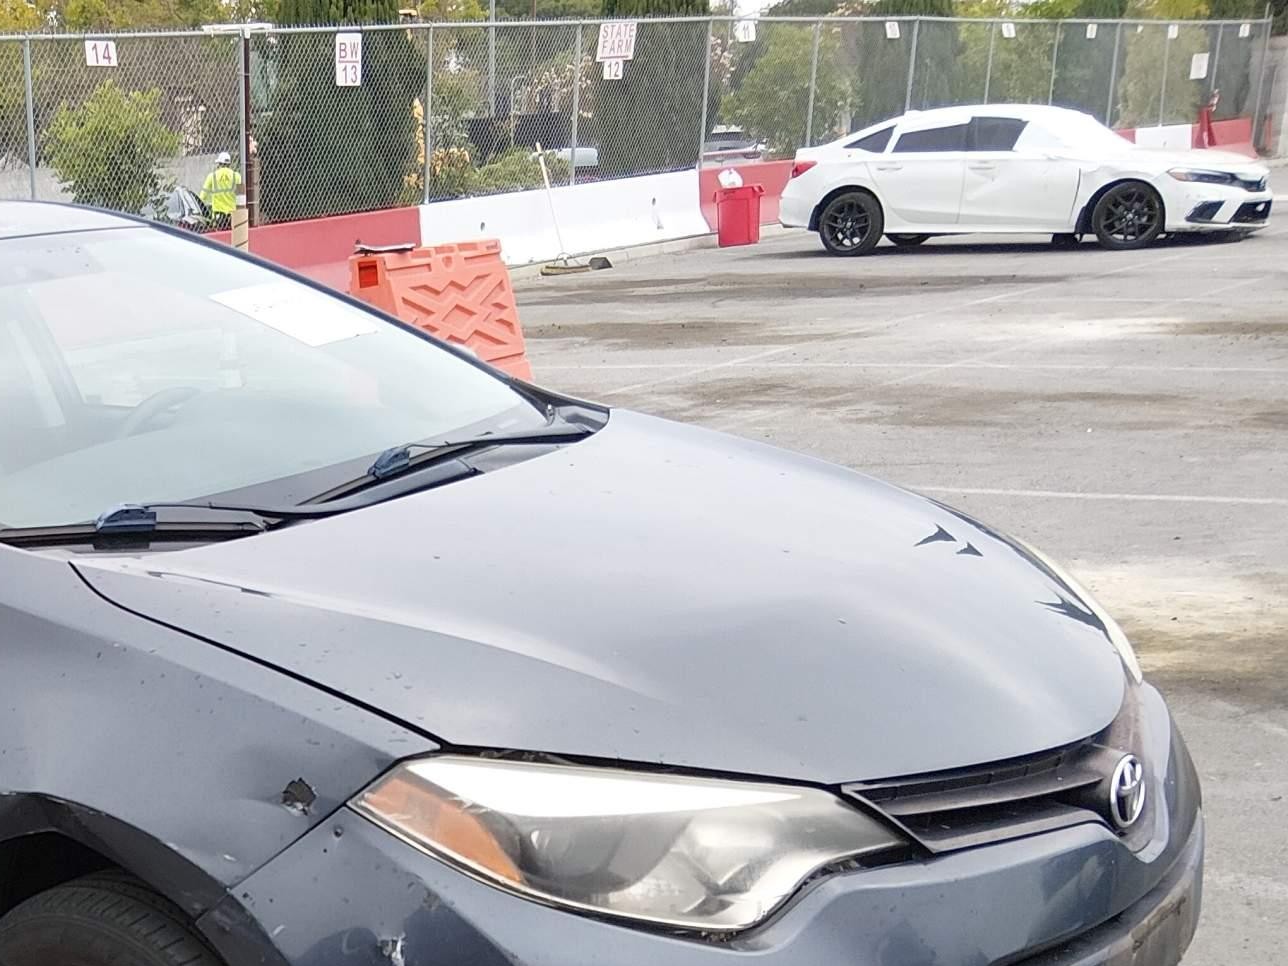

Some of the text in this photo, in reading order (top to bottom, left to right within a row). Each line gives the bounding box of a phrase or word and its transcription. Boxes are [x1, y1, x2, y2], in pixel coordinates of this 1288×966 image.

[603, 24, 635, 38] STATE
[92, 43, 112, 64] 14
[339, 41, 359, 59] BW
[602, 39, 632, 54] FARM
[342, 65, 358, 84] 13
[607, 61, 619, 78] 12
